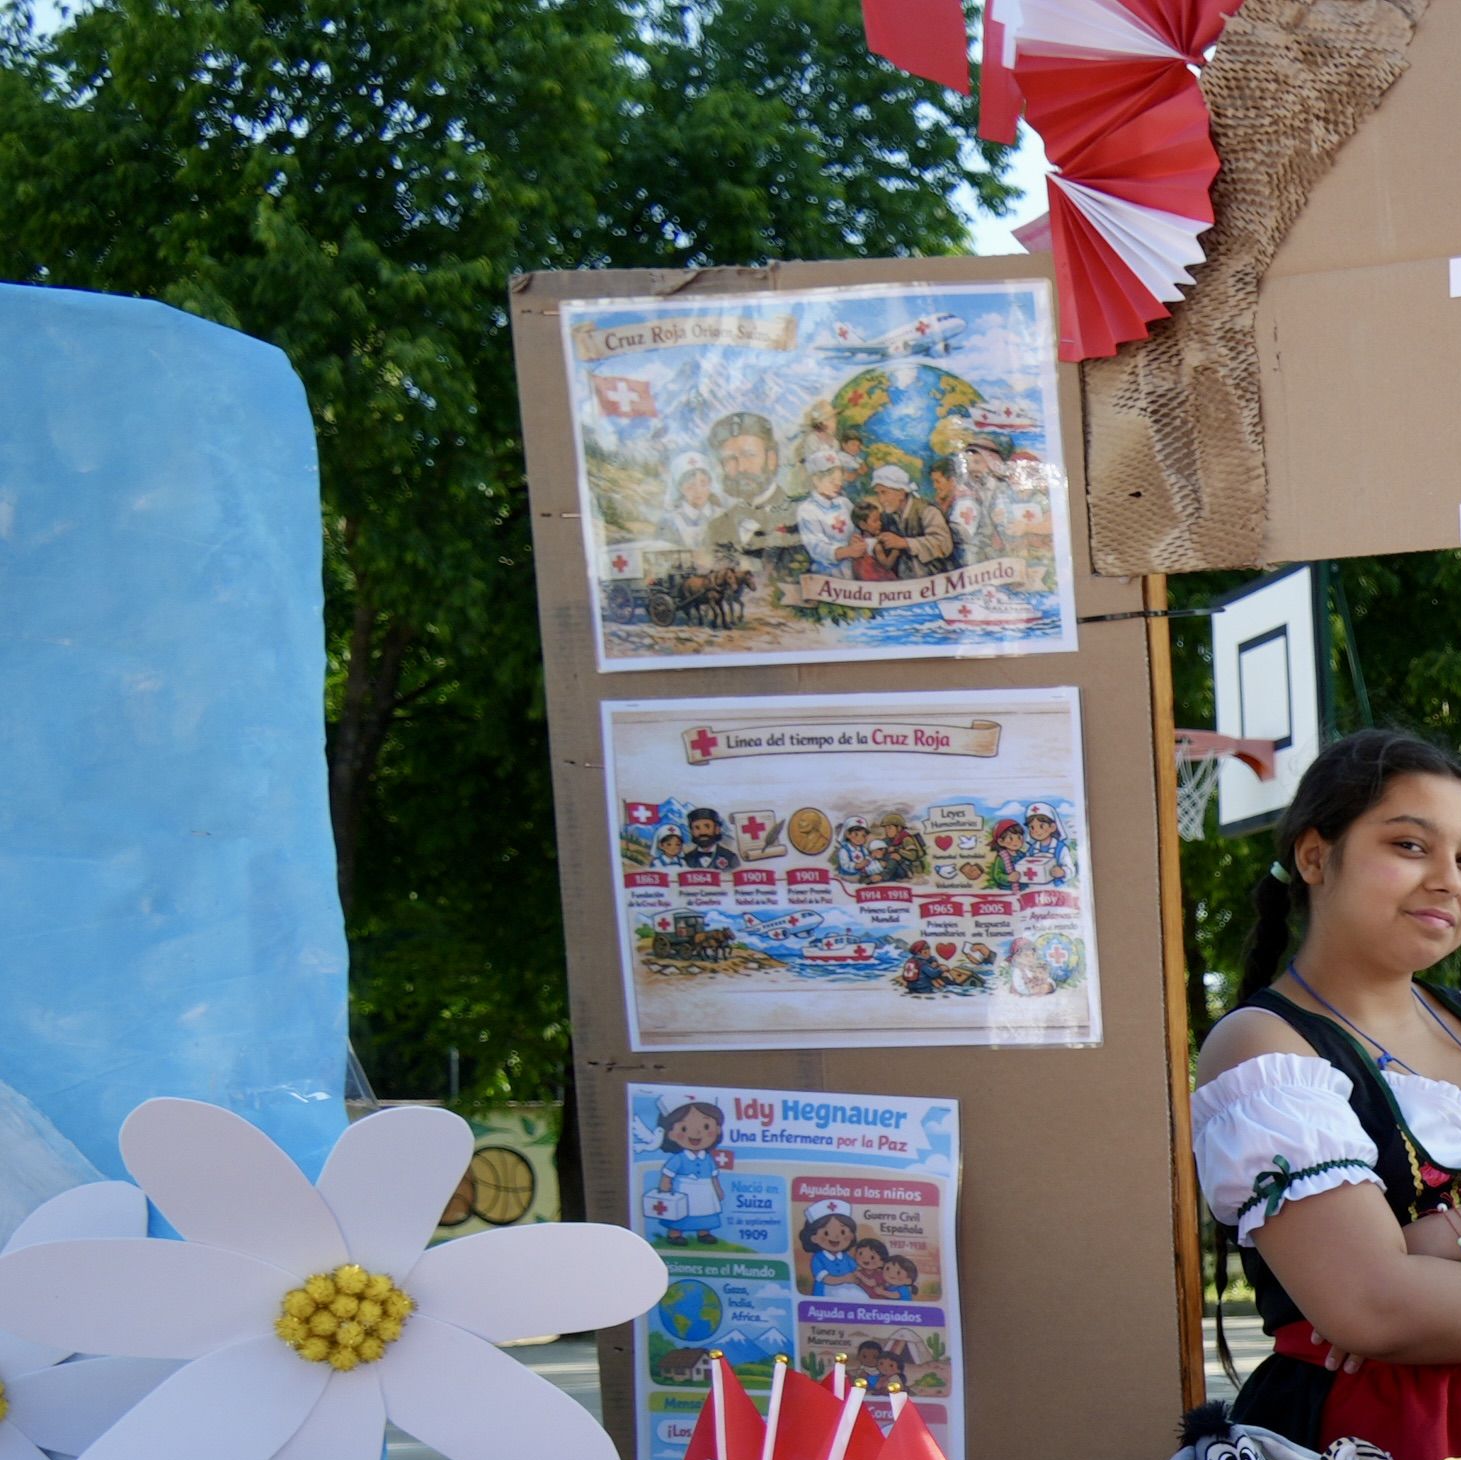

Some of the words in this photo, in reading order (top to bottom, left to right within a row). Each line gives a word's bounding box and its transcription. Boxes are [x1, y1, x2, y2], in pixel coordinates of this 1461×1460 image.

[605, 333, 644, 351] Cruz
[651, 325, 686, 344] Roja
[818, 580, 873, 604] Ayuda
[878, 589, 912, 605] para
[920, 580, 936, 599] el
[944, 562, 1014, 595] Mundo
[766, 733, 785, 746] del
[790, 733, 834, 749] tiempo
[838, 733, 853, 745] de
[857, 732, 868, 744] la
[872, 729, 908, 746] Cruz
[914, 729, 950, 750] Roja
[734, 1097, 774, 1126] Idy
[782, 1100, 907, 1129] Hegnauer
[730, 1130, 757, 1143] Una
[761, 1130, 833, 1145] Enfermera
[837, 1137, 858, 1149] por
[862, 1134, 874, 1148] la
[878, 1136, 908, 1152] Paz
[736, 1196, 772, 1209] Suiza
[799, 1183, 851, 1199] Ayudaba
[853, 1188, 861, 1197] a
[864, 1185, 880, 1199] los
[883, 1186, 922, 1201] niños
[739, 1229, 768, 1241] 1909
